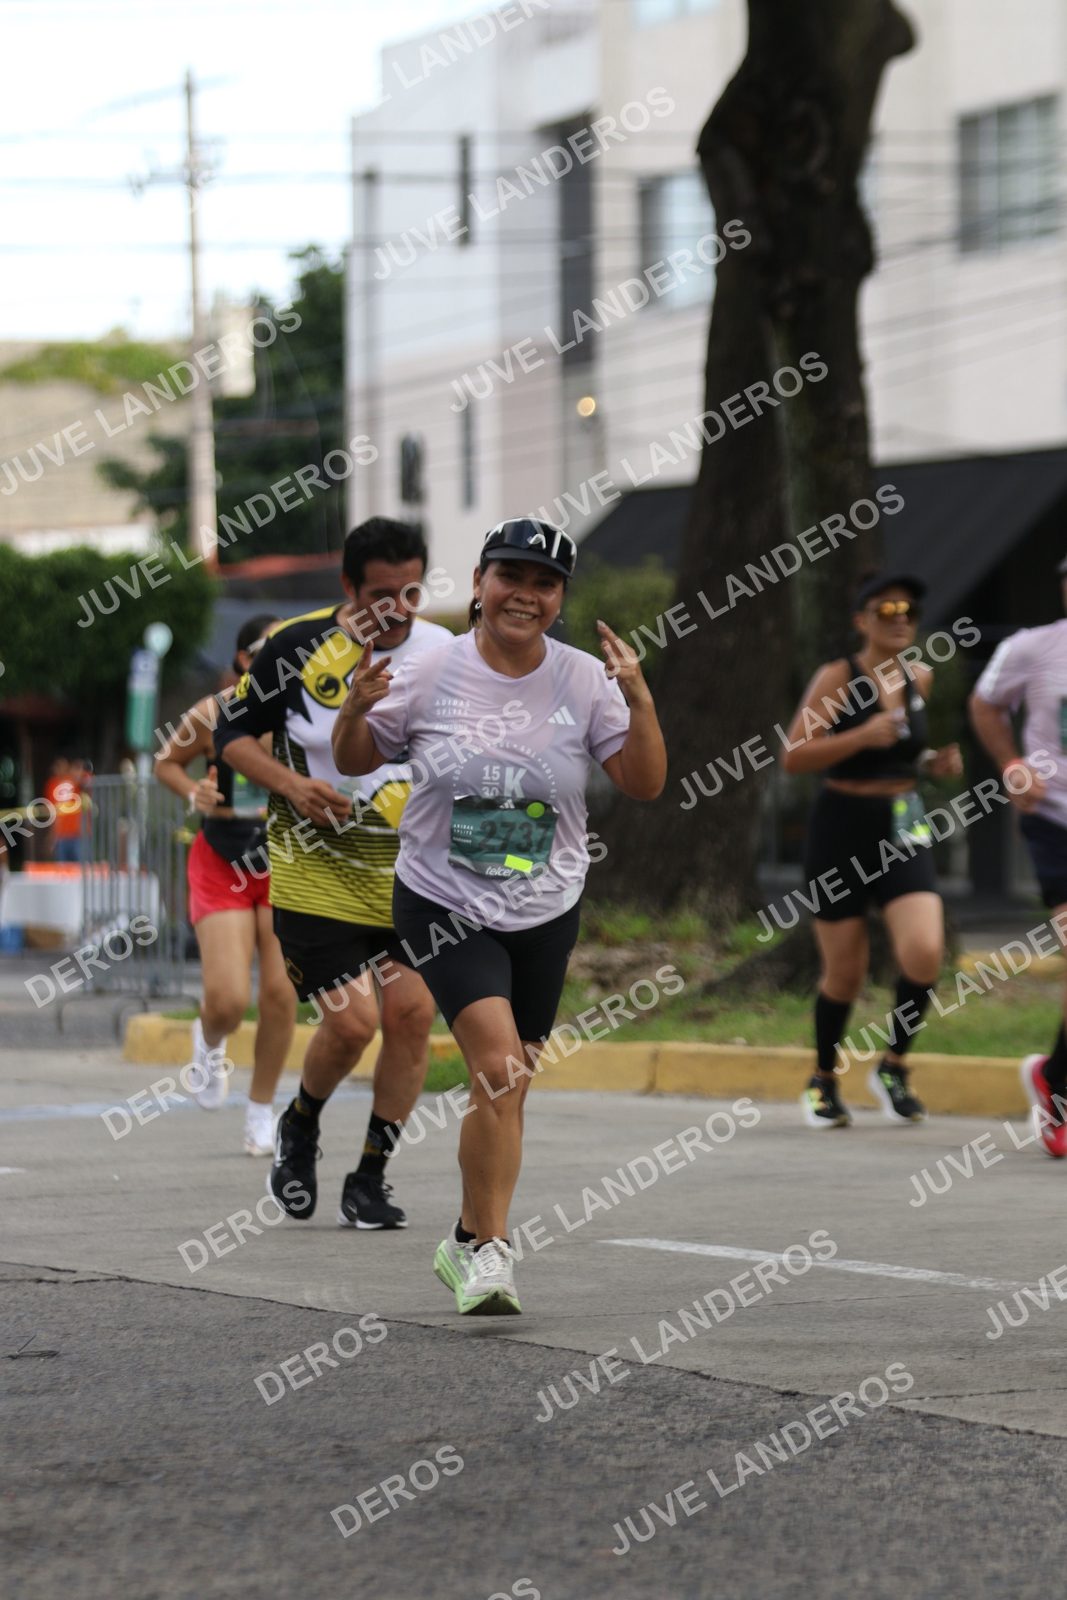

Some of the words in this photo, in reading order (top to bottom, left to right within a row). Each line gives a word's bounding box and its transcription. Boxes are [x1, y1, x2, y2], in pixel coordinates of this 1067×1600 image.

[482, 765, 500, 781] 15
[504, 767, 528, 798] K
[482, 787, 500, 799] 30
[480, 821, 550, 852] 2737
[485, 866, 514, 877] telcel
